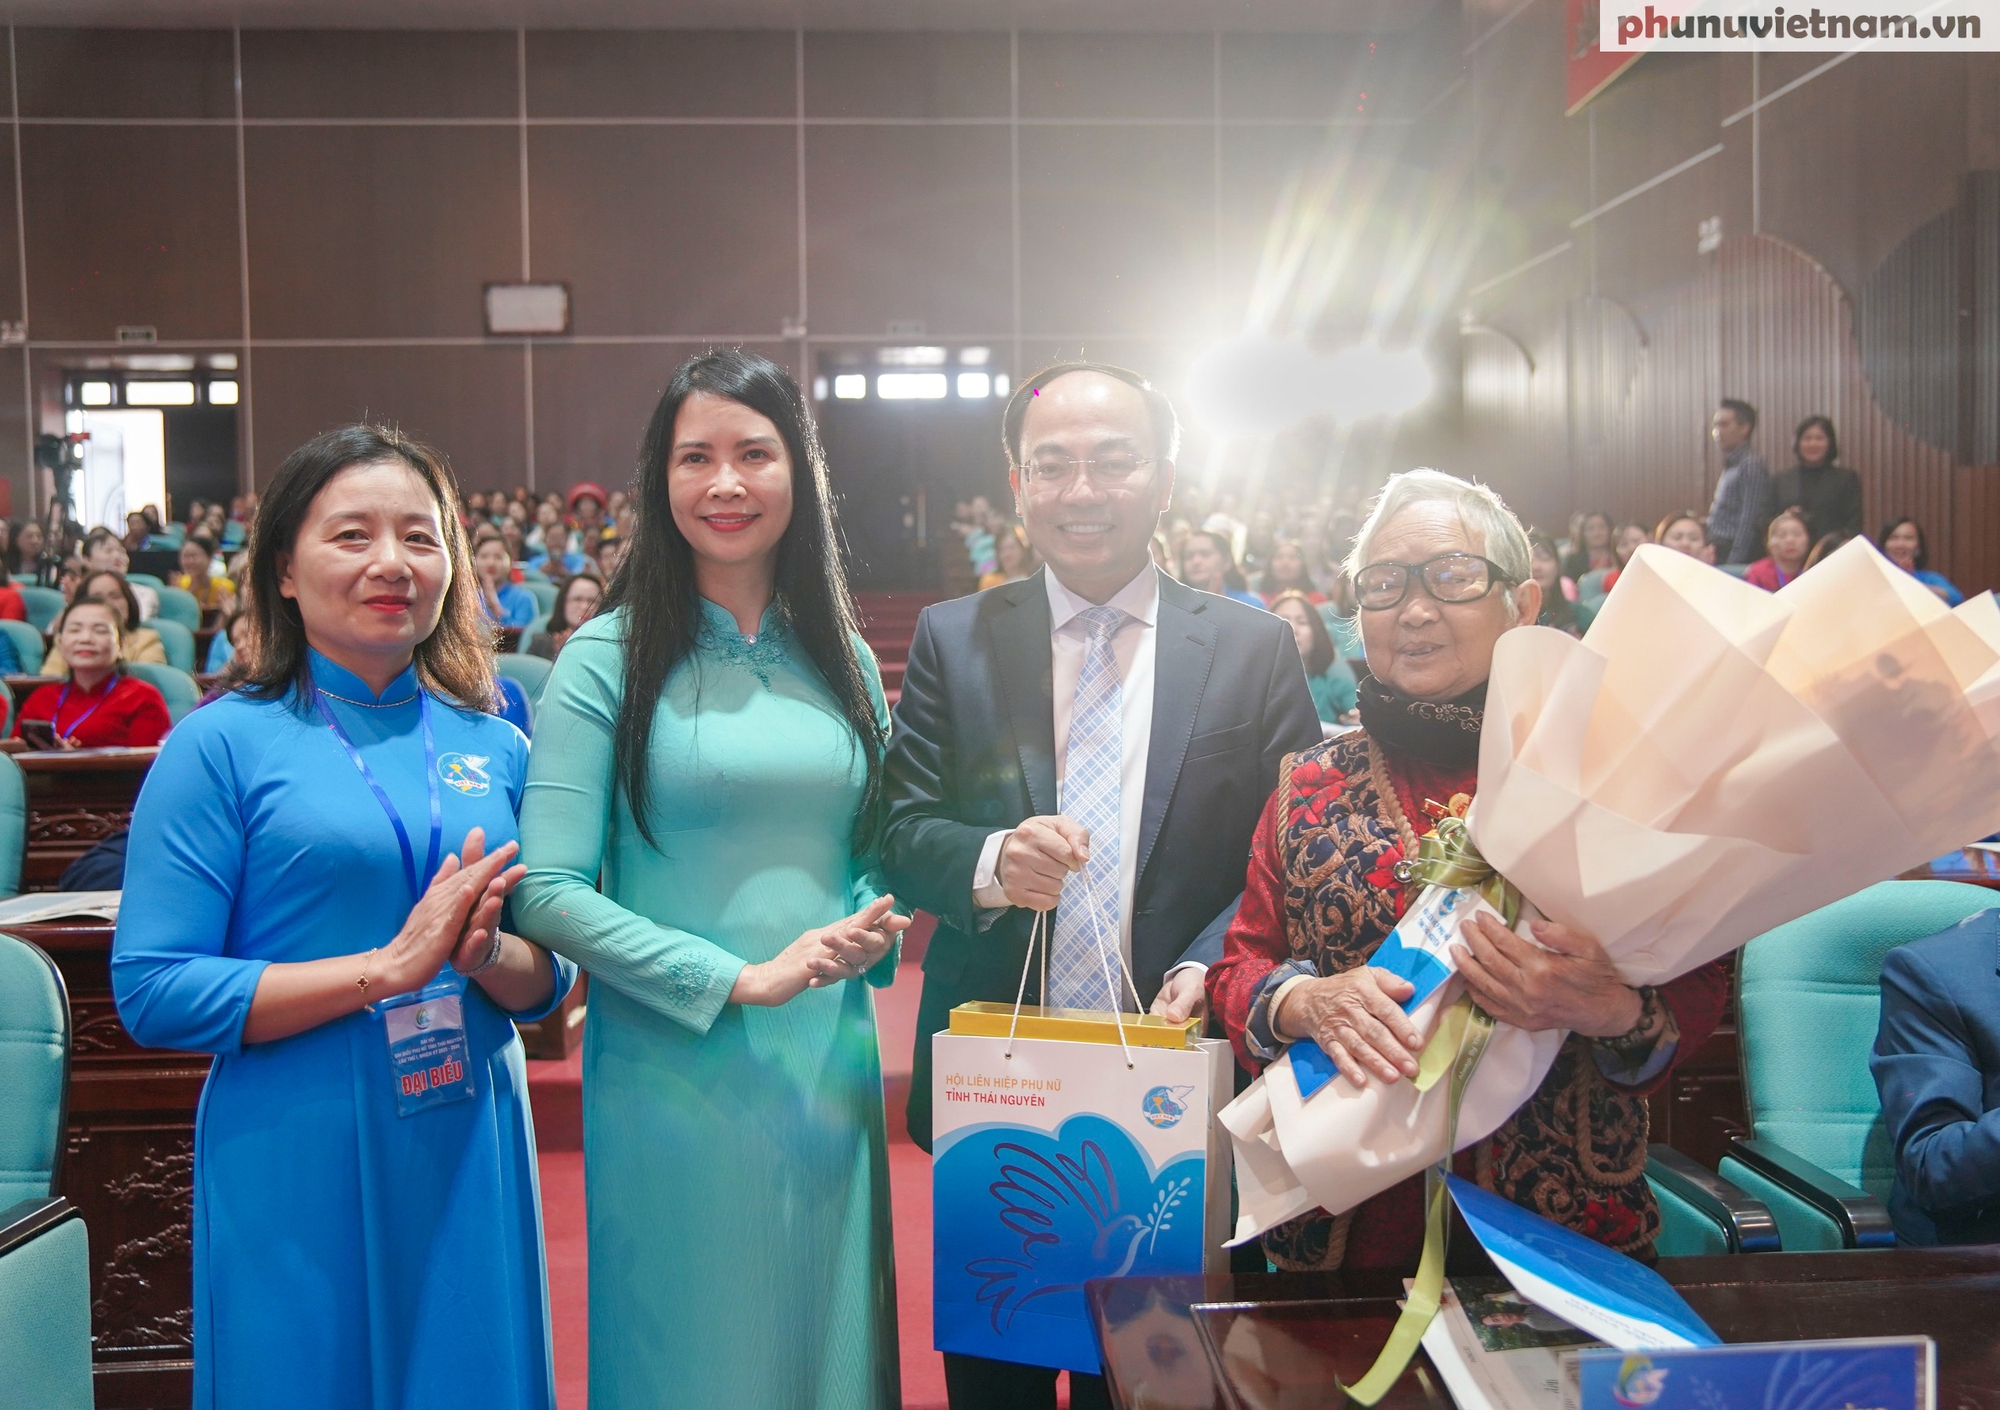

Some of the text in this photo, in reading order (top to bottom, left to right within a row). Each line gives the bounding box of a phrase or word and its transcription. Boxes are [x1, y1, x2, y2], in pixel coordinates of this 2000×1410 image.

[401, 1055, 463, 1097] ĐẠI BIỂU
[945, 1073, 1062, 1092] HỘI LIÊN HIỆP PHỤ NỮ
[945, 1088, 1045, 1107] TỈNH THÁI NGUYÊN
